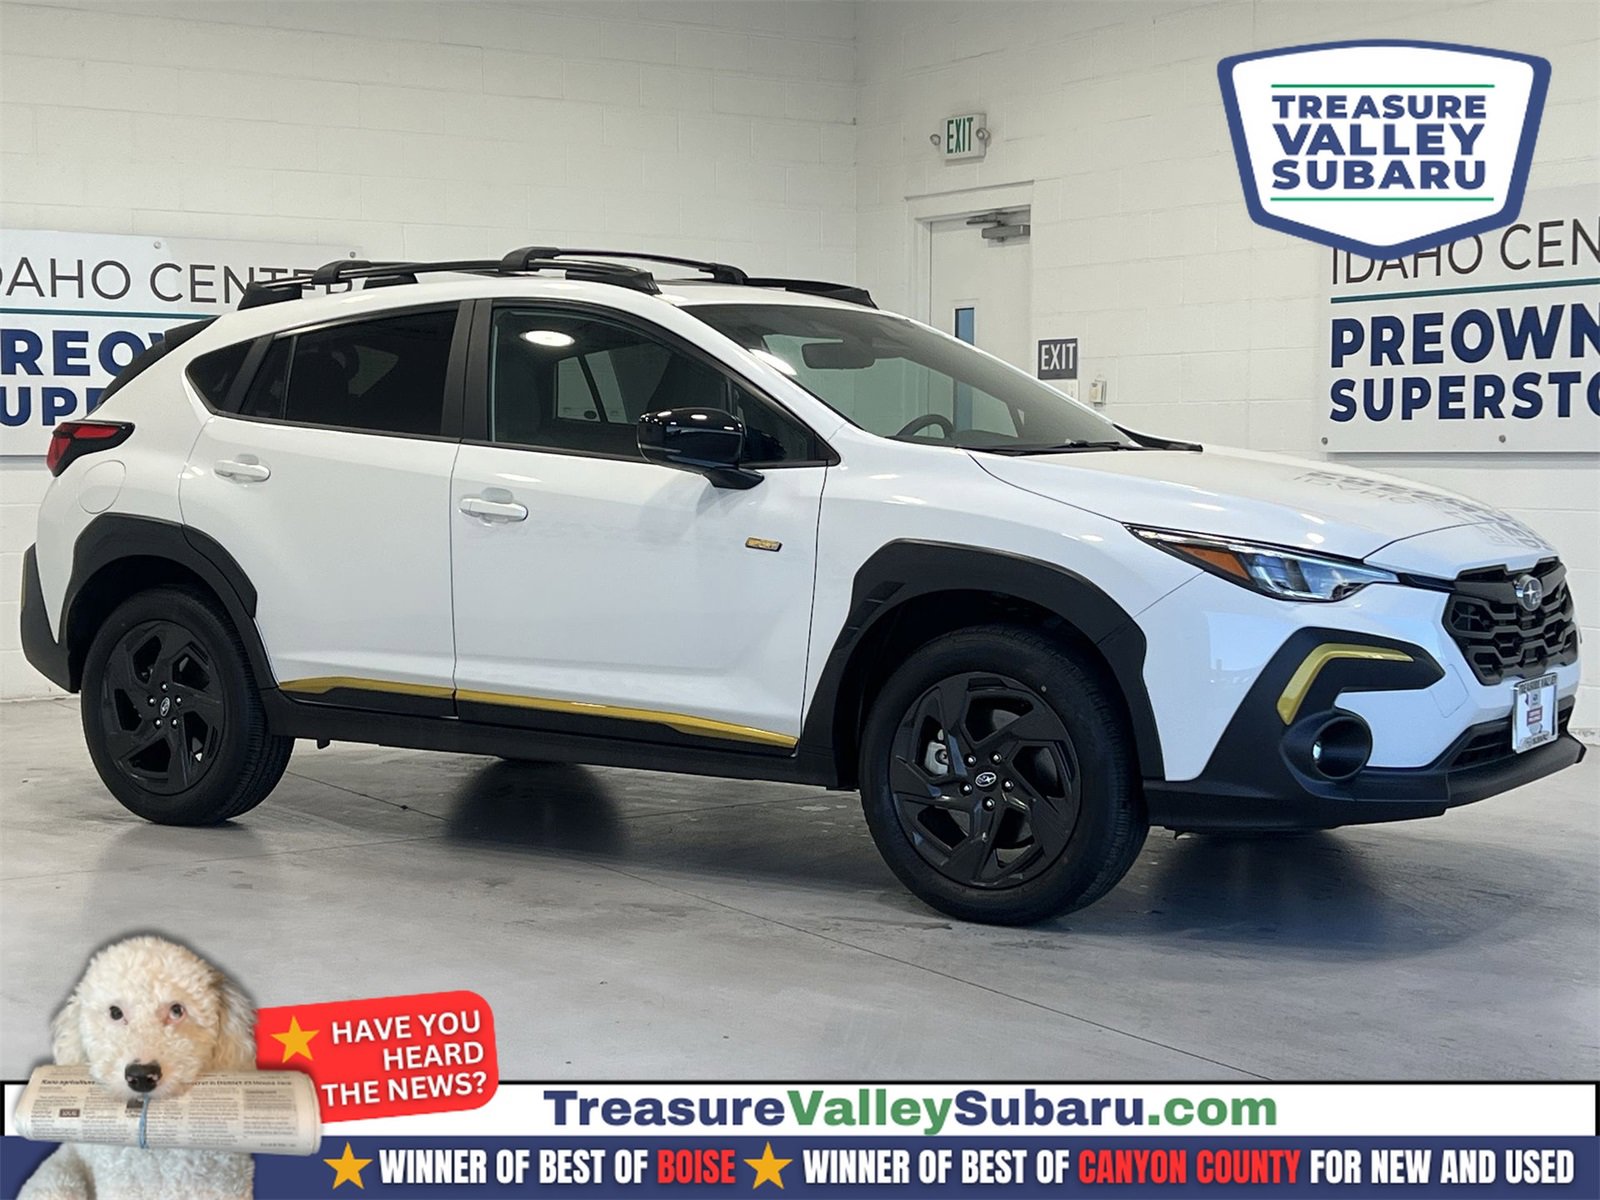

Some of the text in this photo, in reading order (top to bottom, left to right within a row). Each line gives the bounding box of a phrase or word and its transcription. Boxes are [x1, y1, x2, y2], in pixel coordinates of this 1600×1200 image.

[946, 116, 974, 154] EXIT
[0, 256, 131, 300] AHO
[0, 328, 166, 377] REO
[1040, 342, 1077, 371] EXIT
[1330, 301, 1600, 369] PREOWN
